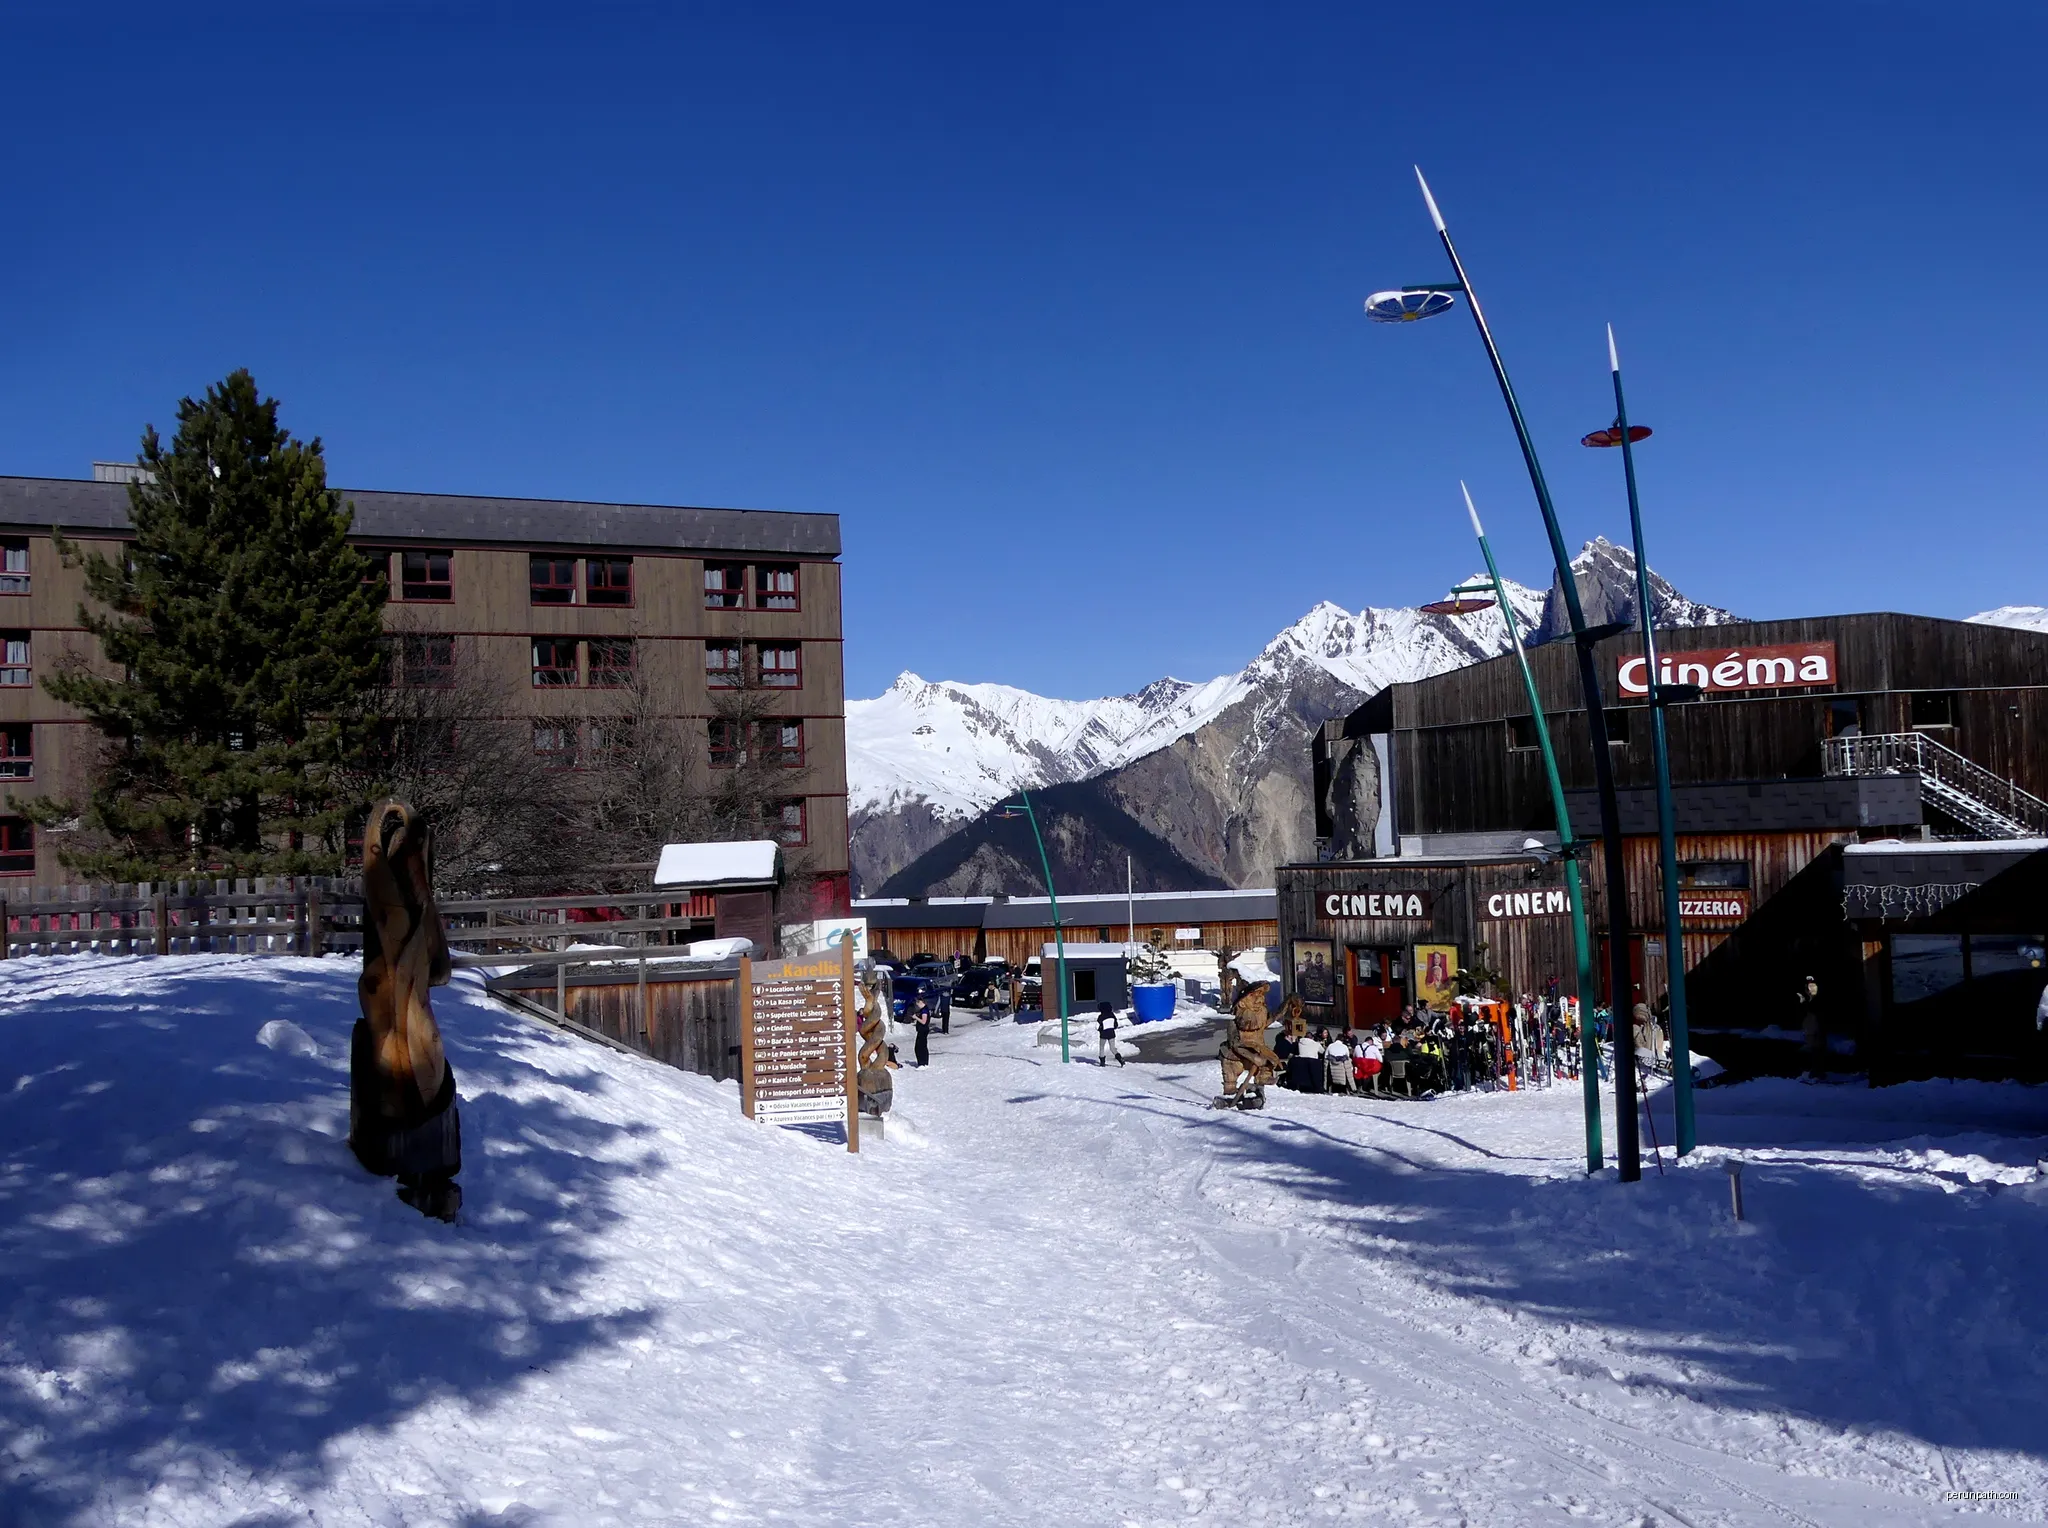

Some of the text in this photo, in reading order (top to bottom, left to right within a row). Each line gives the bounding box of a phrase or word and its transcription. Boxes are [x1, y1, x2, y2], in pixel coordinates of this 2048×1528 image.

[1618, 652, 1829, 693] Cinéma
[1325, 894, 1423, 916] CINEMA
[1488, 891, 1571, 917] CINEM
[1678, 901, 1742, 915] IZZERIA
[769, 985, 794, 993] Location
[770, 1010, 799, 1019] Supérette
[808, 1009, 828, 1018] Sherpa
[771, 1024, 793, 1032] Cinéma
[780, 1049, 799, 1057] Panier
[799, 1048, 826, 1057] Savoyard
[780, 1062, 807, 1070] Vordache
[789, 1075, 802, 1083] Crok
[772, 1086, 835, 1097] Intersport côté Forum
[790, 1100, 813, 1108] Vacances
[794, 1113, 816, 1121] Vacances
